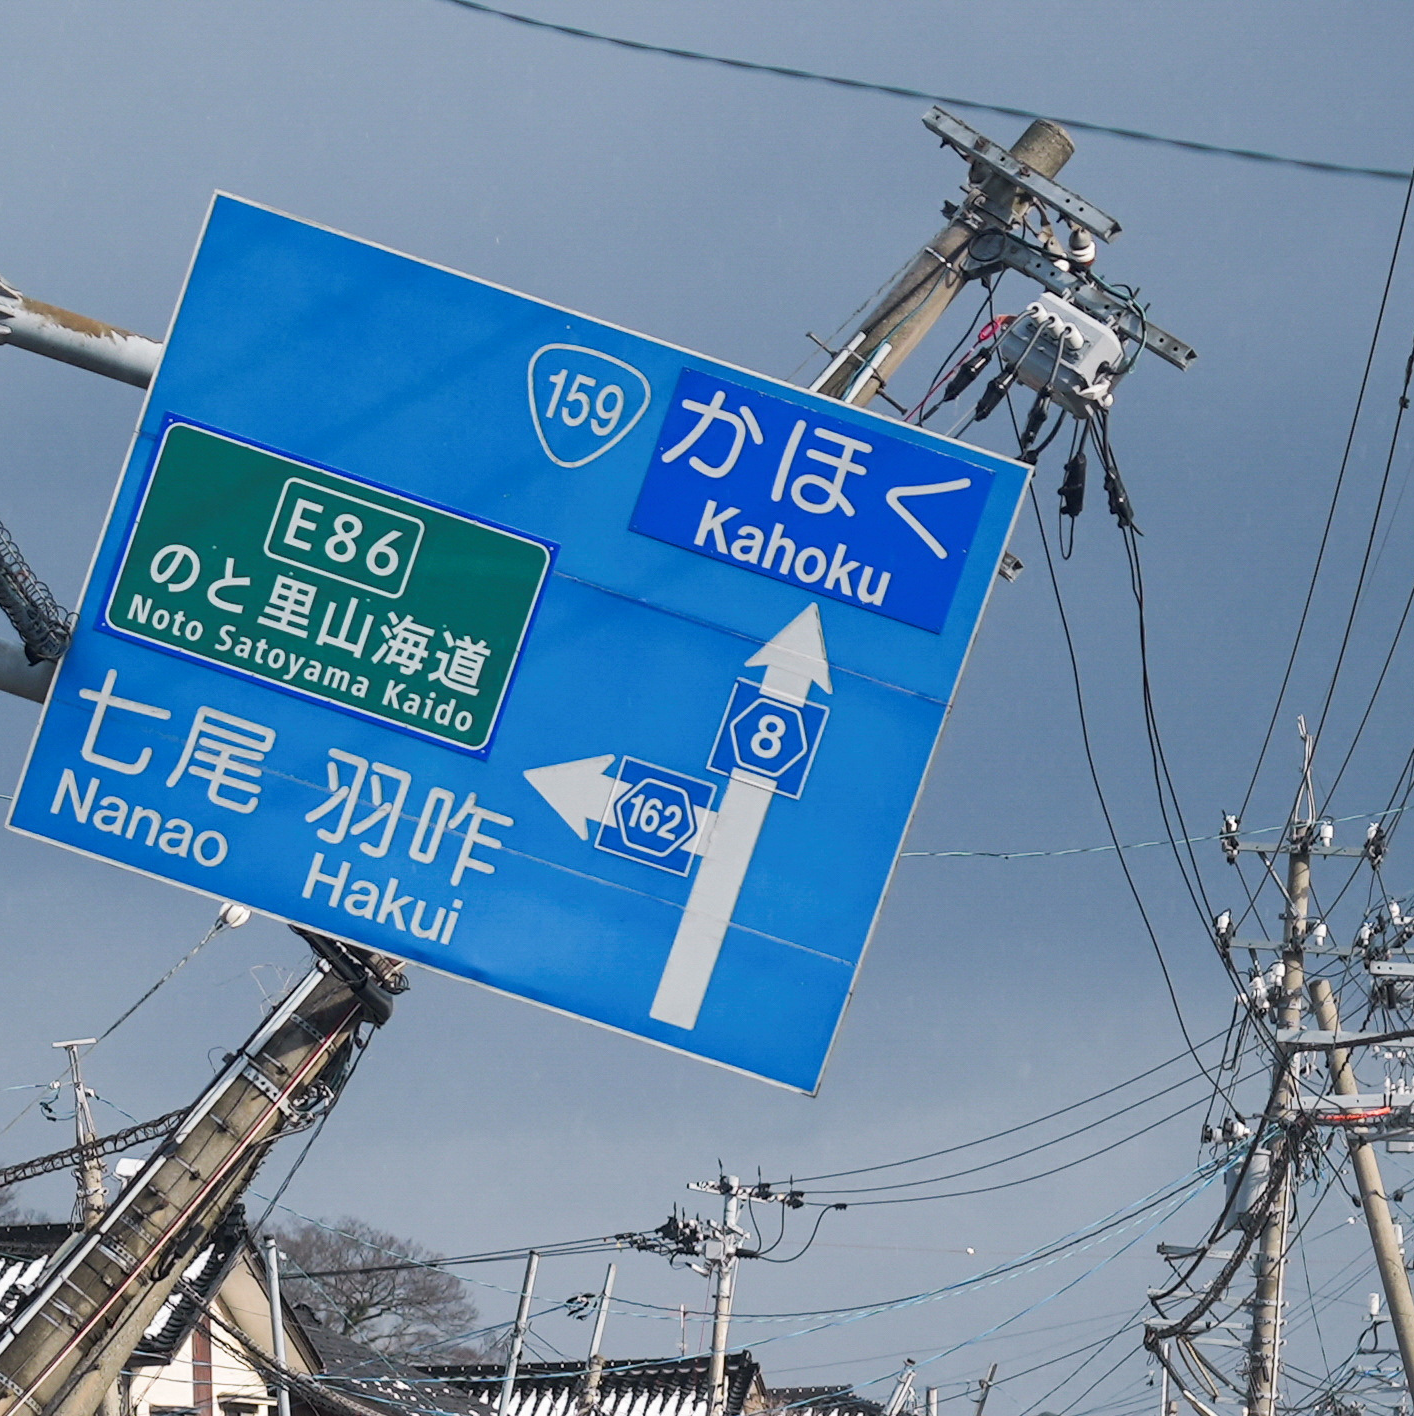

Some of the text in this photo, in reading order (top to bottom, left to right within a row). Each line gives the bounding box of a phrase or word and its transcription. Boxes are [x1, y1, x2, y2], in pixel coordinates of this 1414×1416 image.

[545, 368, 625, 437] 159
[283, 497, 404, 577] E86
[661, 391, 972, 560] かほく
[694, 500, 892, 608] Kahoku
[127, 594, 474, 733] Noto Satoyama Kaido
[149, 543, 492, 698] のと里山海道
[79, 668, 515, 887] 七尾 羽咋
[750, 714, 787, 759] 8
[50, 769, 464, 947] Nanao Hakui
[629, 793, 683, 841] 162
